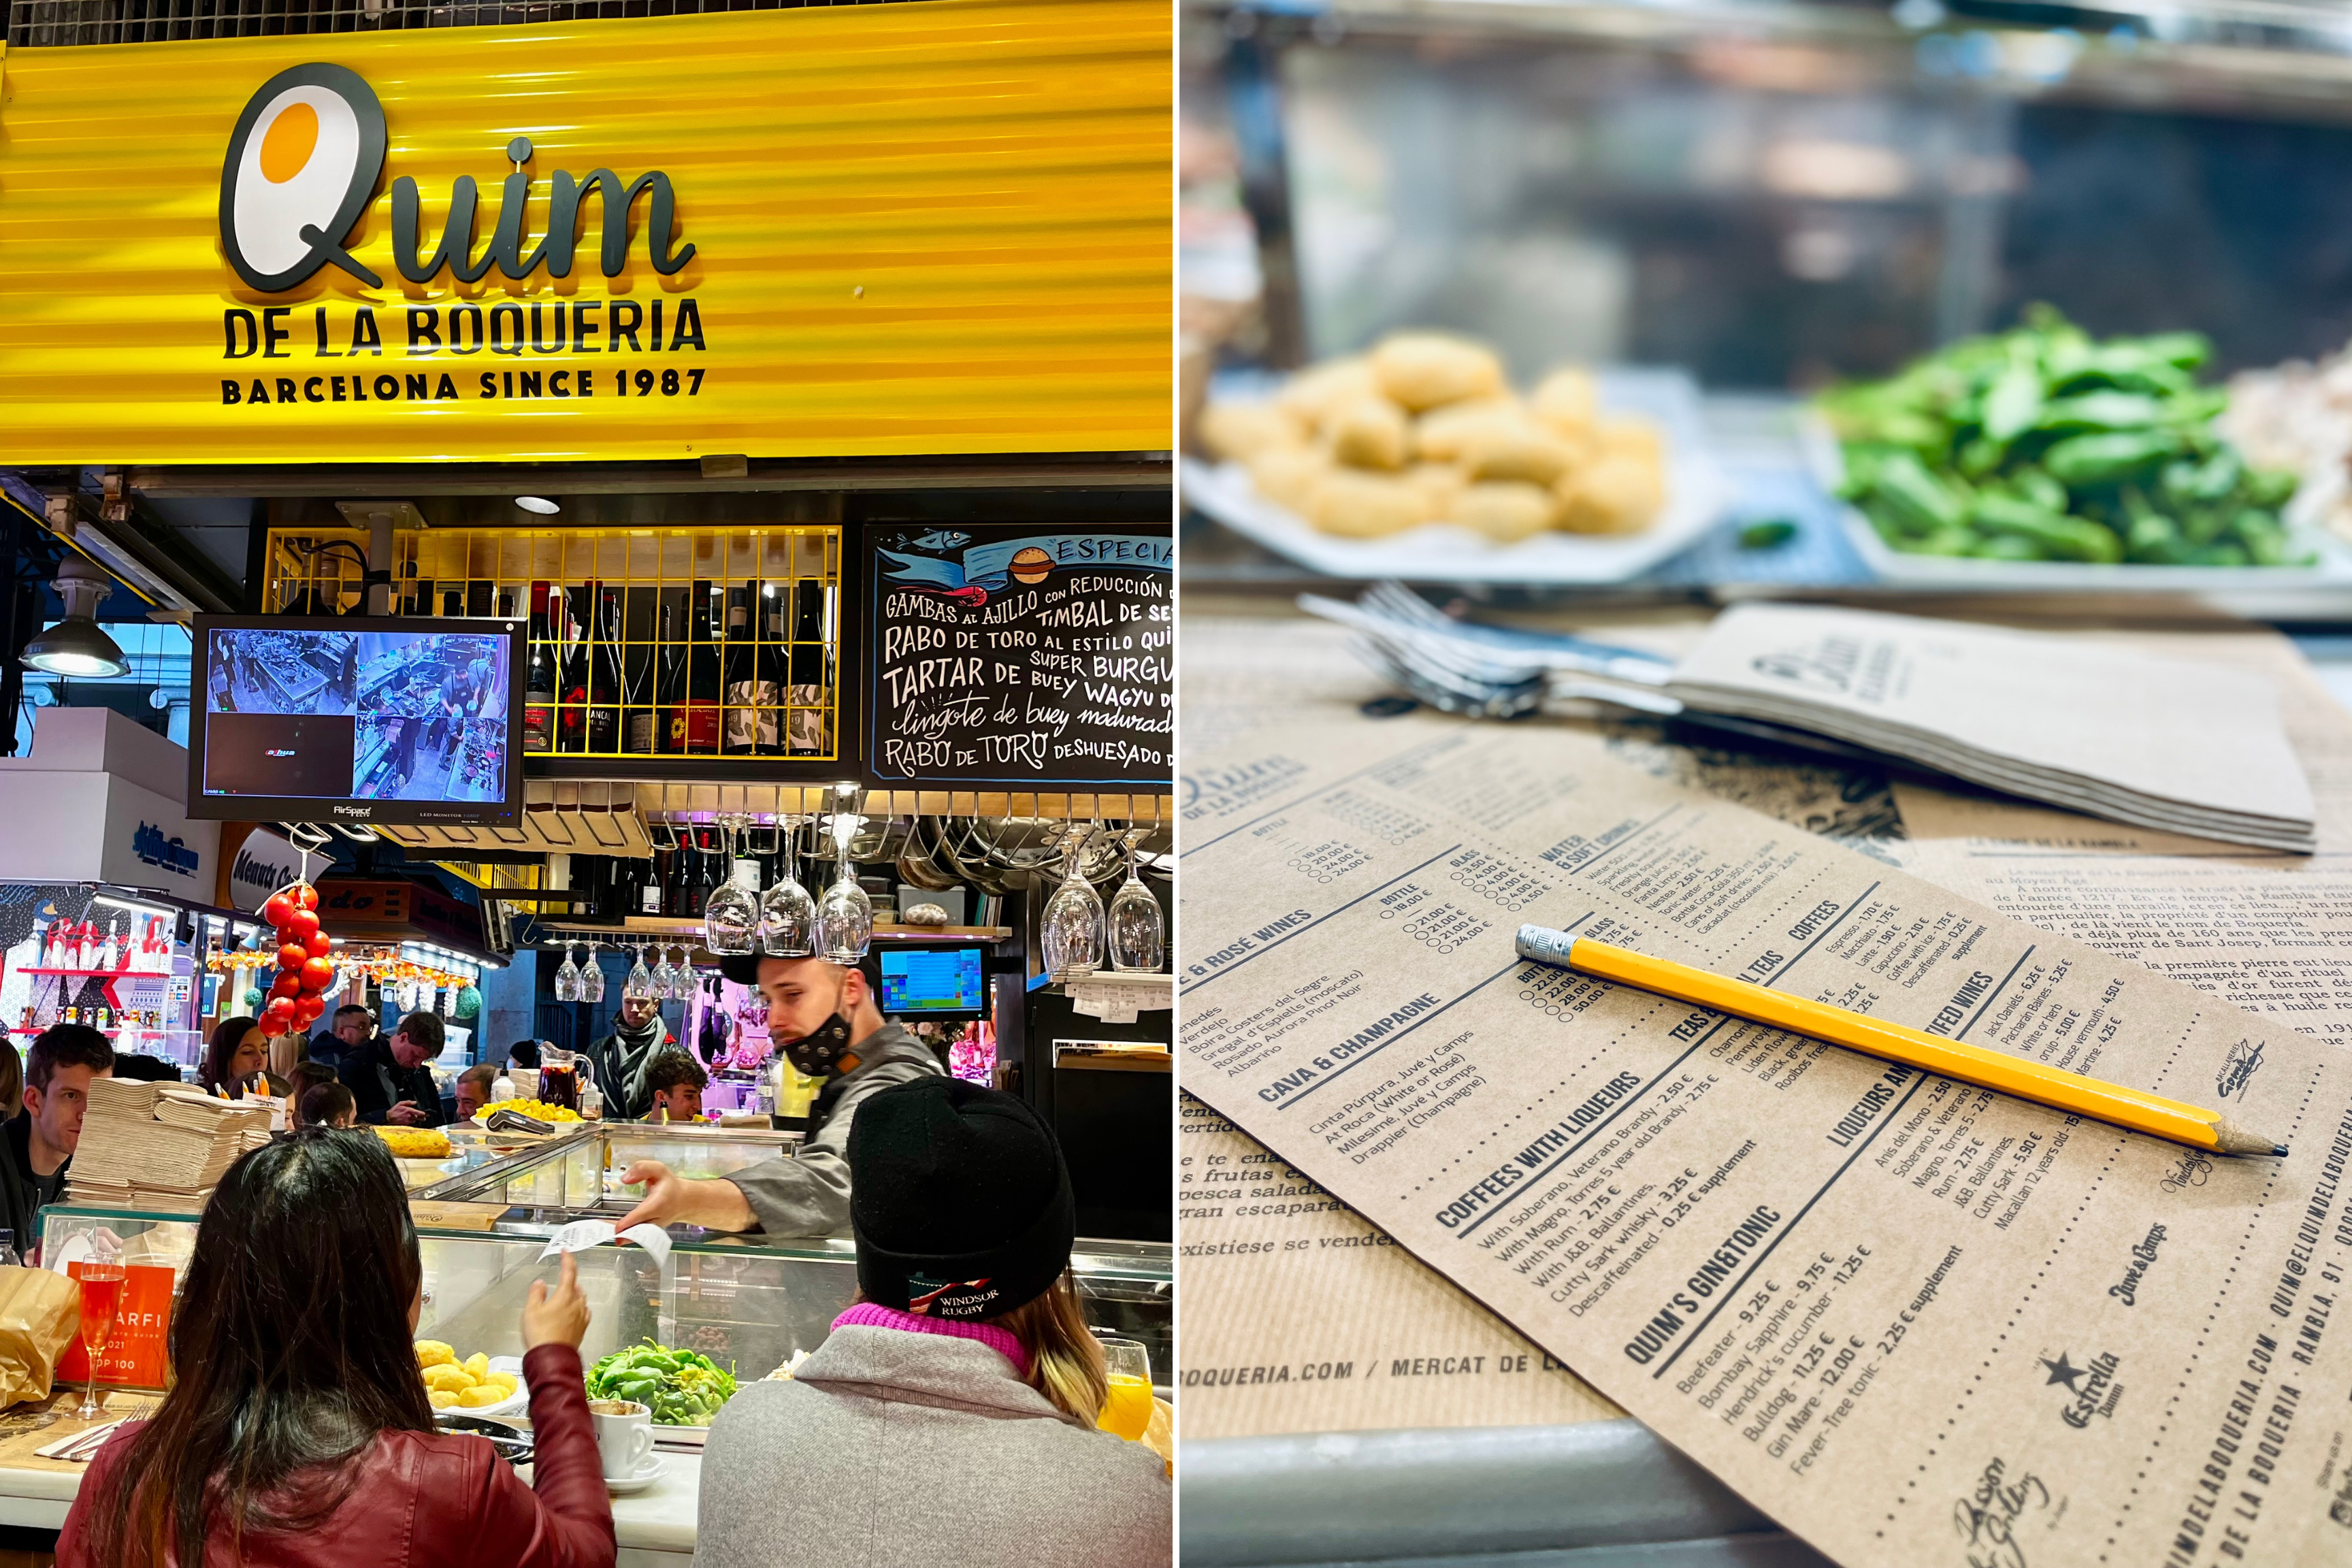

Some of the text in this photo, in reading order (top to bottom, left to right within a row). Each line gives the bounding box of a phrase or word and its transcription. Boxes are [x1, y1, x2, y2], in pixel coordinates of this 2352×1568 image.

[219, 62, 696, 293] Quim
[223, 298, 707, 359] DE LA BOQUERIA
[220, 368, 706, 406] BARCELONA SINCE 1987
[886, 574, 1162, 625] GAMBAS AL AJILLO CON REDUCCIÓN
[1120, 603, 1142, 621] DE
[1148, 604, 1173, 621] SE
[885, 625, 946, 664] RABO
[956, 631, 979, 649] DE
[987, 631, 1036, 649] TORO
[1045, 635, 1064, 650] AL
[1029, 651, 1086, 677] SUPER
[883, 657, 1021, 708] TARTAR DE
[1032, 670, 1077, 698] BUEY
[1084, 682, 1154, 708] WAGYU
[892, 690, 1173, 740] lingote de buey madurad
[885, 730, 1161, 777] RABO DE TORO DESHUESADO
[334, 806, 372, 817] AirSpace
[1449, 849, 1480, 867] GLASS
[1379, 883, 1420, 905] BOTTLE
[1645, 889, 1676, 911] Nestea
[1676, 872, 1698, 887] 2,50
[1997, 902, 2065, 911] entourée
[2069, 902, 2112, 910] d'une
[2116, 902, 2185, 911] muraille,
[1583, 917, 1615, 938] GLASS
[1787, 900, 1840, 941] COFFEES
[1825, 924, 1860, 953] Espresso
[1858, 906, 1877, 921] 1,70
[1188, 909, 1311, 976] & ROSÉ WINES
[2174, 937, 2335, 948] Sant Josep, formant
[1747, 950, 1784, 975] TEAS
[1950, 971, 1993, 1009] WINES
[1983, 1019, 2004, 1037] Jack
[1995, 993, 2024, 1021] Daniels
[2020, 971, 2040, 990] 6,25
[2225, 992, 2330, 1001] richesse que
[2265, 1000, 2328, 1011] à huile
[1188, 975, 1330, 1054] Boira Costers del Segre
[1200, 969, 1364, 1061] Gregal d'Espiells (moscato)
[1211, 983, 1361, 1069] Rosado Aurora Pinot Noir
[1668, 1013, 1709, 1042] TEAS
[1227, 1045, 1281, 1077] Albariño
[1257, 992, 1441, 1102] CAVA & CHAMPAGNE
[2216, 1043, 2240, 1082] BACALLANERIES
[1309, 1030, 1473, 1134] Cinta Púrpura, Juvé y Camps
[1350, 1075, 1486, 1164] Drappier (Champagne)
[1825, 1082, 1895, 1147] LIQUEURS
[1435, 1071, 1640, 1228] COFFEES WITH LIQUEURS
[1203, 1168, 1273, 1182] frutas
[1284, 1239, 1310, 1251] se
[1512, 1250, 1548, 1274] With
[1543, 1225, 1578, 1251] Rum
[1579, 1194, 1611, 1220] 2,75
[1550, 1270, 1589, 1303] Cutty
[1584, 1244, 1618, 1271] Sark
[1614, 1207, 1659, 1244] whisky
[1657, 1176, 1688, 1202] 3,25
[2132, 1222, 2168, 1262] Camps
[939, 1289, 1000, 1307] WINDSOR
[1624, 1205, 1780, 1365] QUIM'S GIN&TONIC
[116, 1311, 161, 1328] ARFI
[942, 1304, 984, 1316] RUGBY
[108, 1341, 125, 1350] 021
[1676, 1330, 1735, 1394] Beefeater
[1738, 1290, 1770, 1323] 9,25
[96, 1359, 135, 1370] OP 100
[1390, 1354, 1528, 1377] MERCAT DE
[2061, 1352, 2120, 1428] Estrella
[2219, 1261, 2344, 1560] DE LA BOQUERIA RAMBLA, 91
